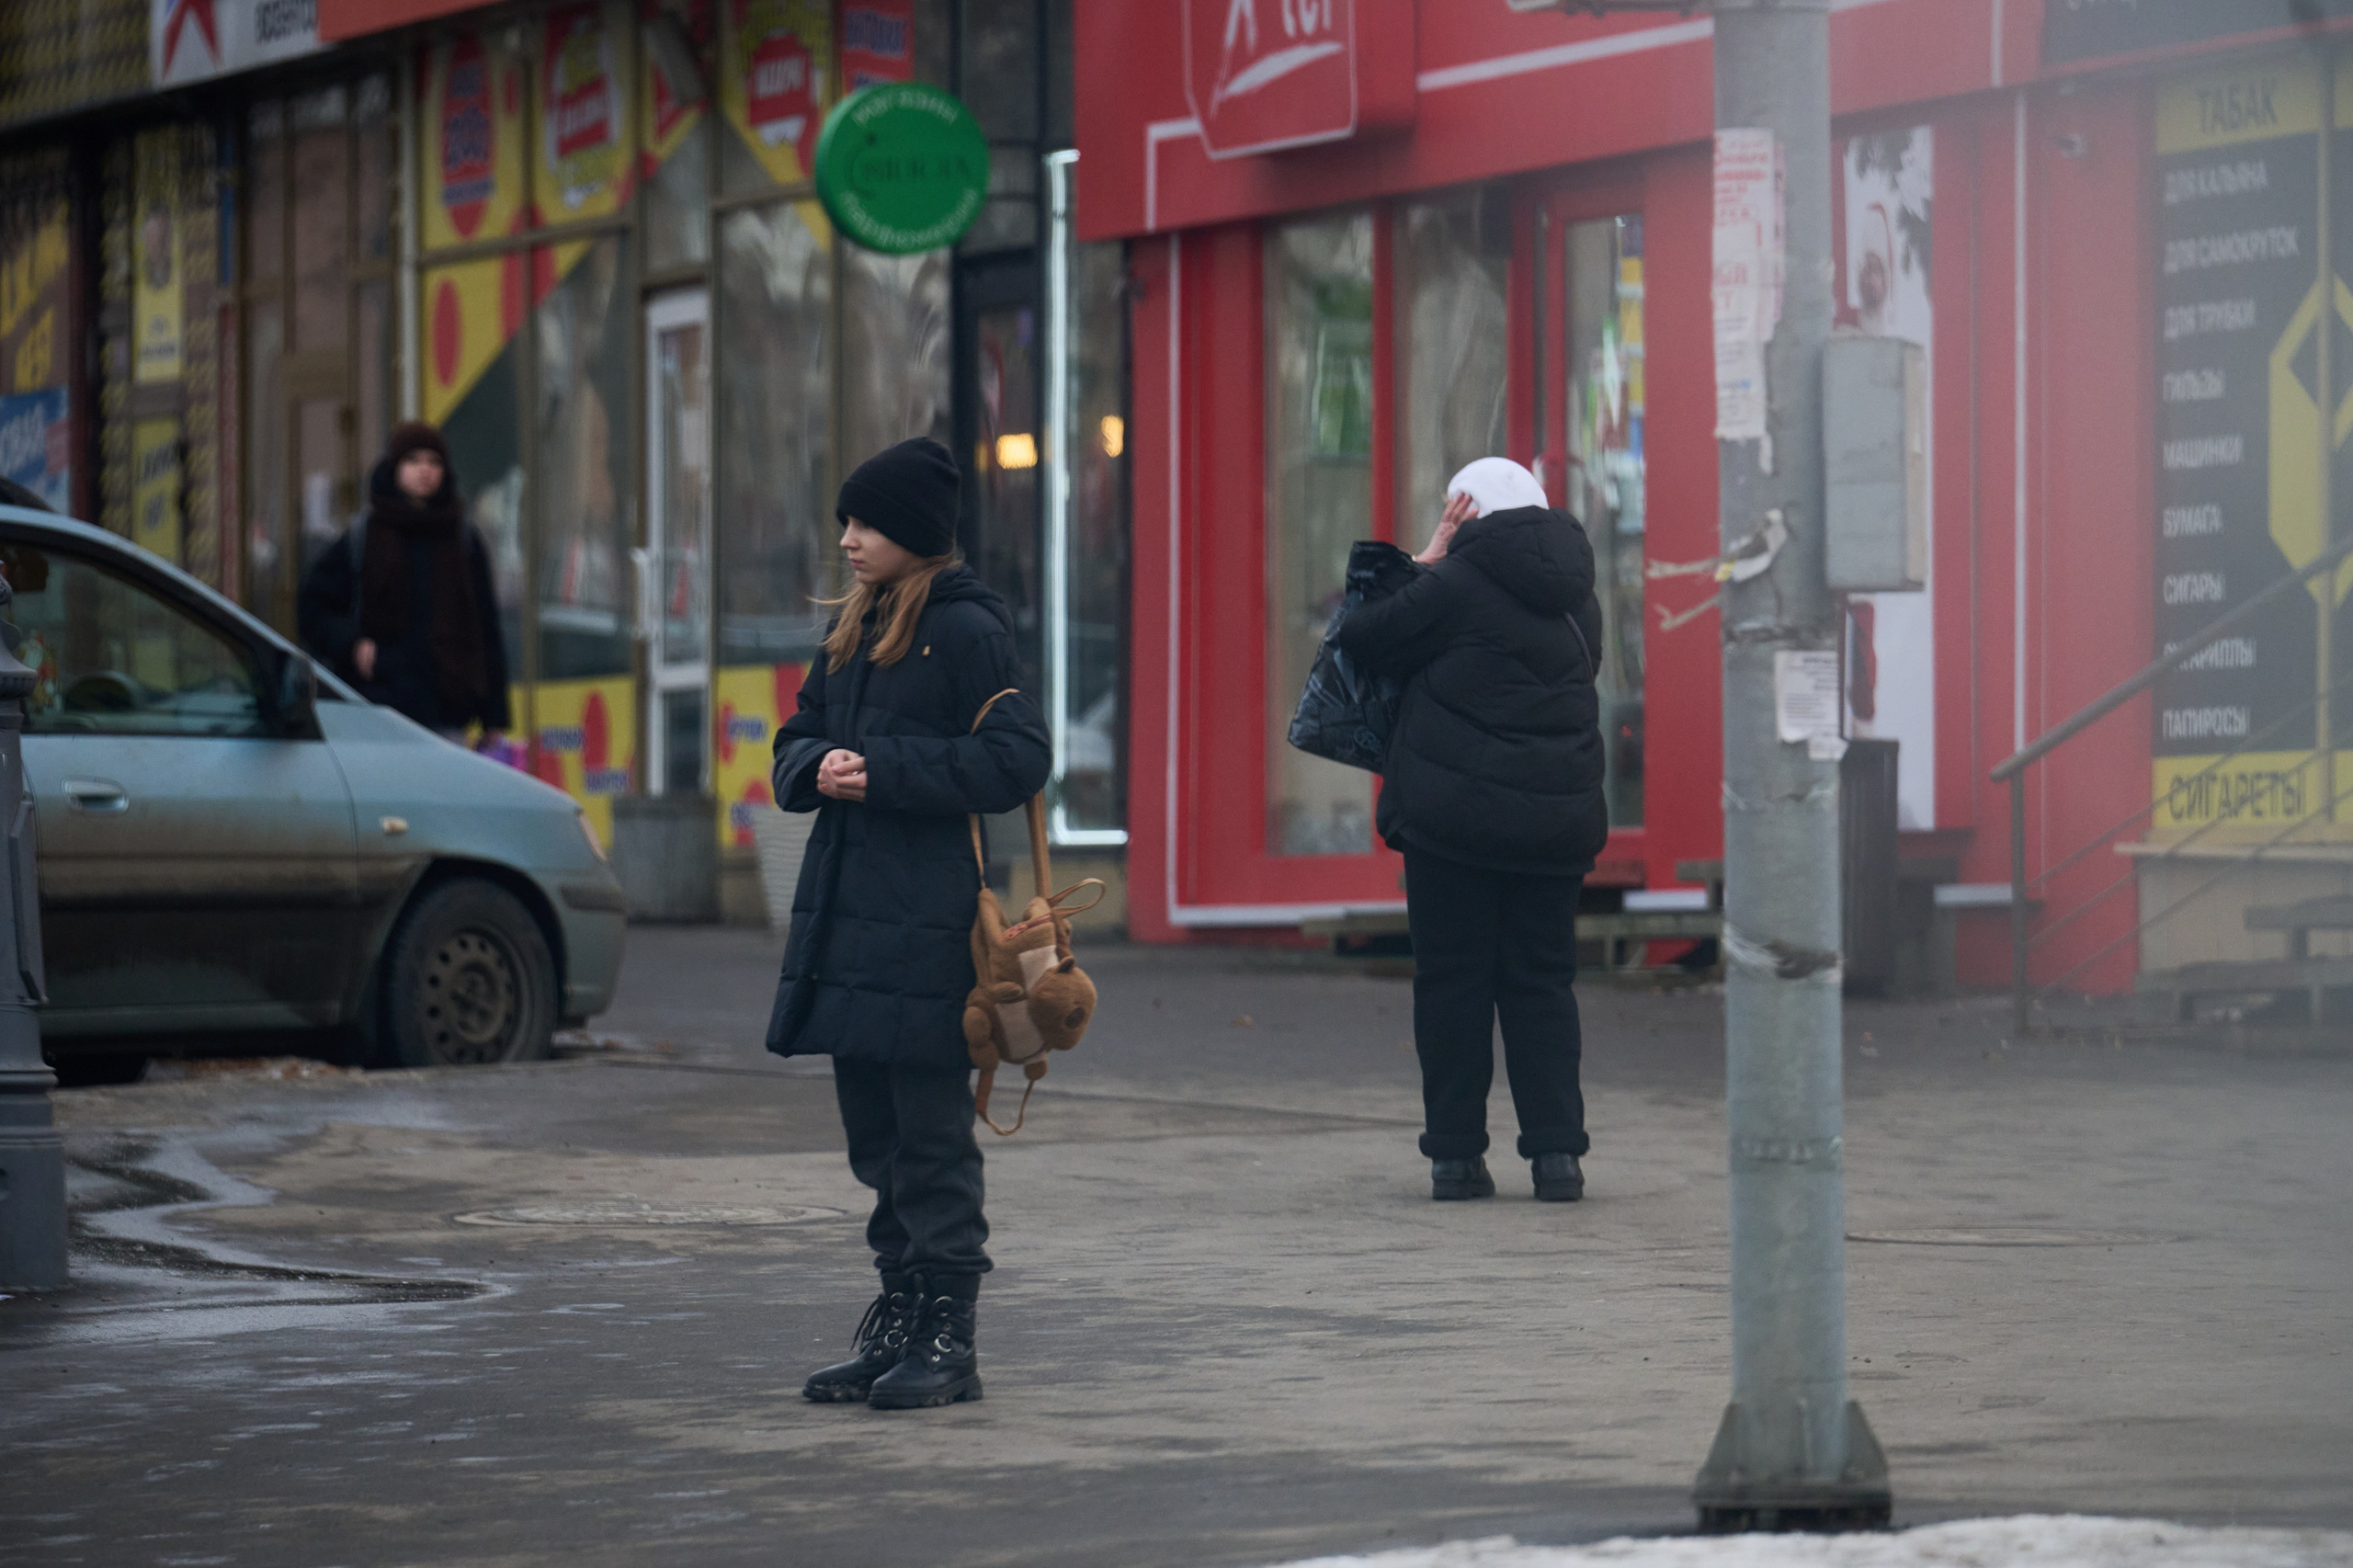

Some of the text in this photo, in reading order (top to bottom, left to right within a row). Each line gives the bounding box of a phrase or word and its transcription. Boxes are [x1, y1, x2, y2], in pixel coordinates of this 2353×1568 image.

[2198, 78, 2278, 134] ТАБАК
[2199, 226, 2300, 267] САМОКРУТОК
[2163, 435, 2244, 470] МАШИНКИ
[2163, 505, 2222, 537] БУМАГА
[2163, 572, 2224, 604] СИГАРЫ
[2163, 706, 2250, 738] ПАПИРОСЫ
[2169, 770, 2306, 821] СИГАРЕТЫ
